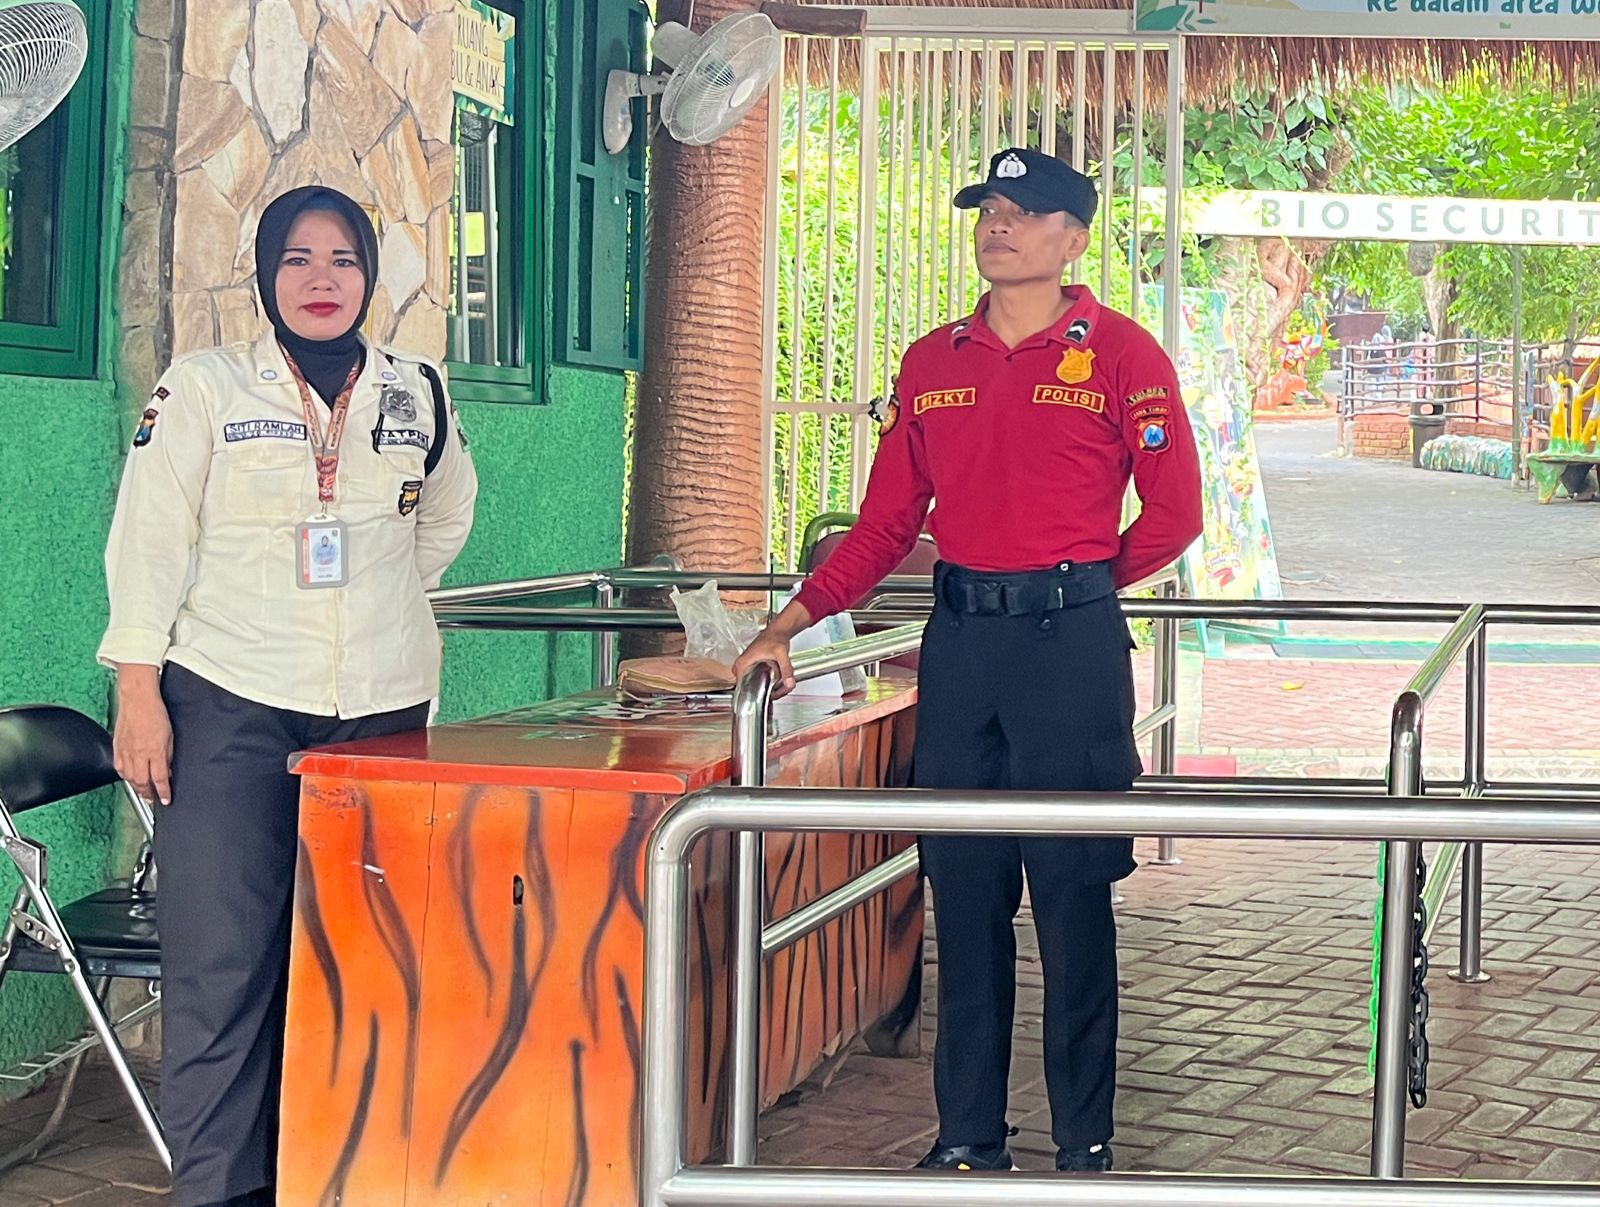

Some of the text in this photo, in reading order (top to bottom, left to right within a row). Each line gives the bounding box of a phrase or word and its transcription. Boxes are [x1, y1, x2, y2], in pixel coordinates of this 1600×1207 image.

[1410, 0, 1489, 14] dalam
[1500, 0, 1558, 14] area
[1571, 0, 1600, 15] w
[457, 13, 489, 57] RUANG
[451, 49, 501, 98] BU & ANAK
[1261, 198, 1600, 237] BIO SECURIT
[921, 392, 967, 408] RIZKY
[1041, 388, 1097, 408] POLISI
[254, 421, 302, 433] RAMLAH
